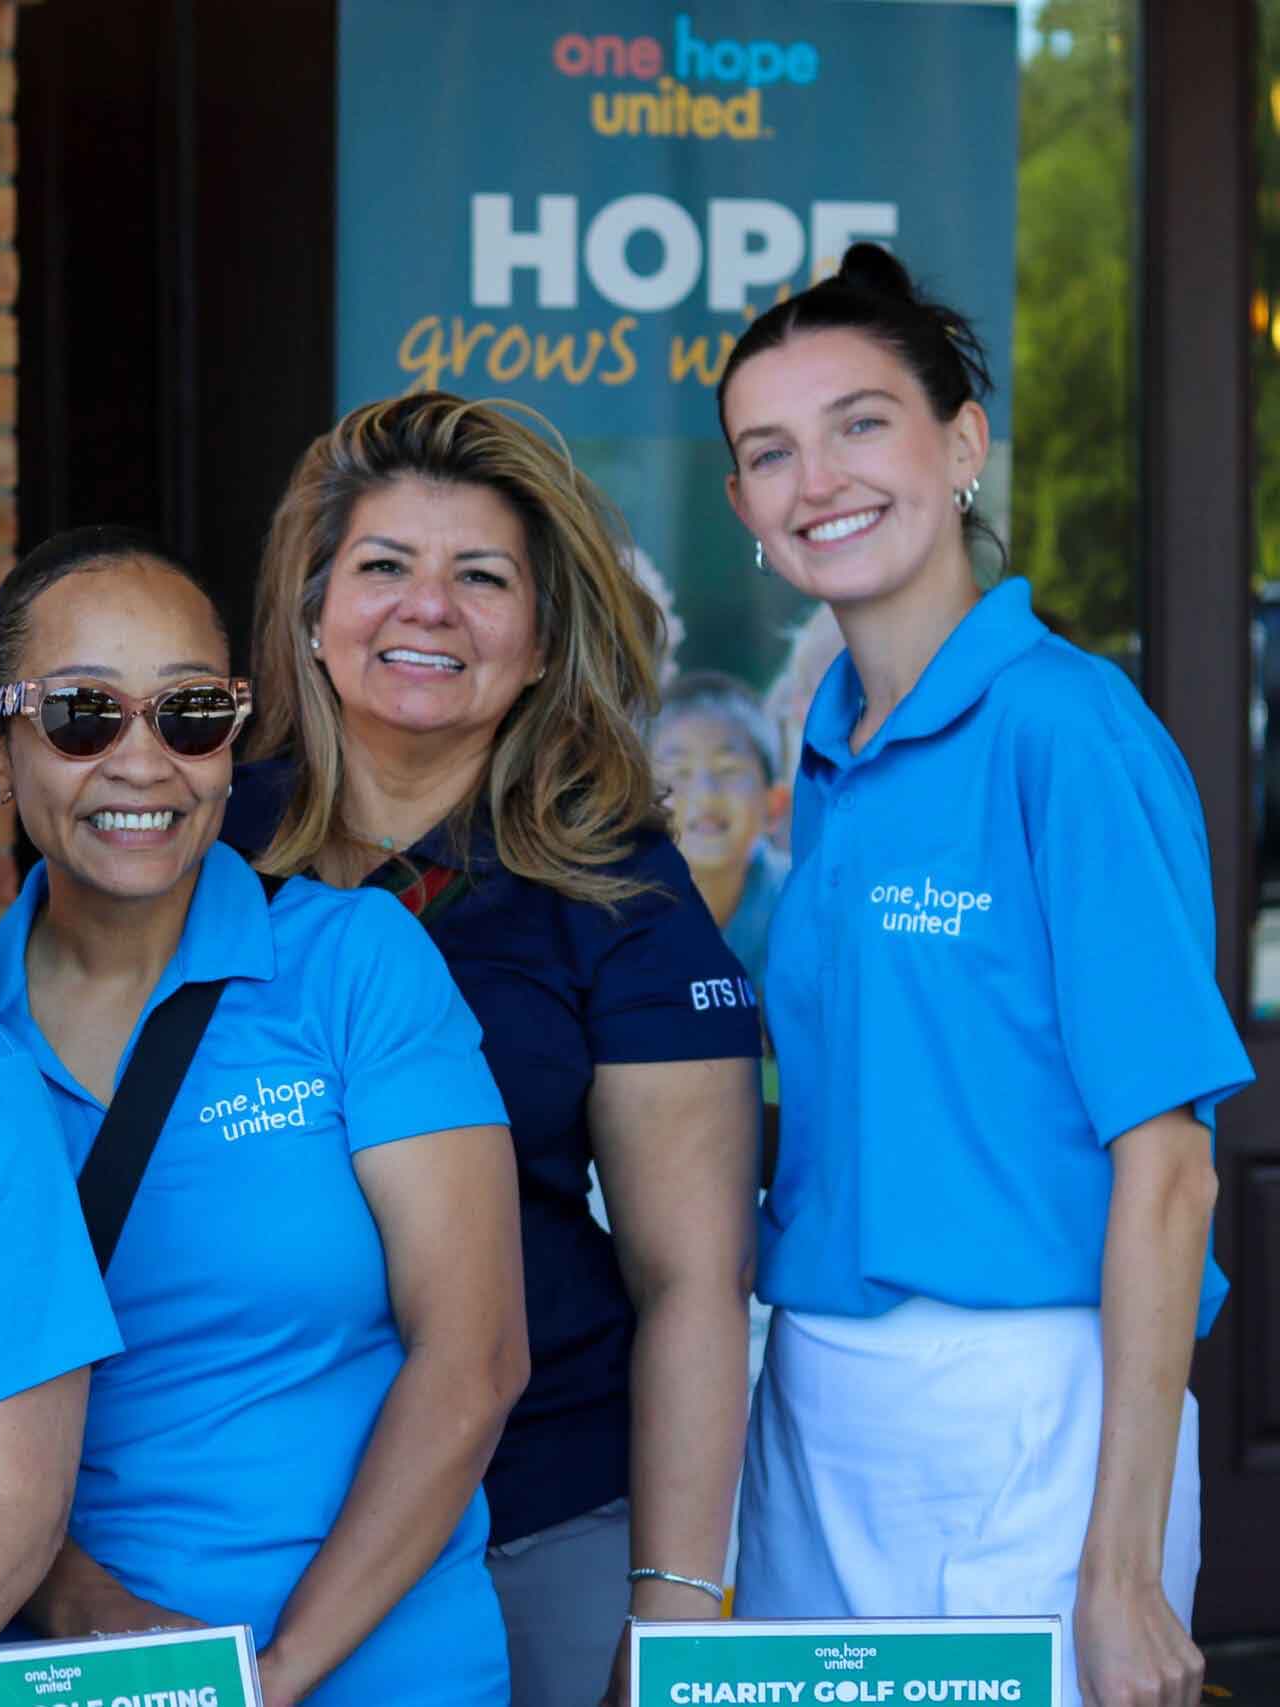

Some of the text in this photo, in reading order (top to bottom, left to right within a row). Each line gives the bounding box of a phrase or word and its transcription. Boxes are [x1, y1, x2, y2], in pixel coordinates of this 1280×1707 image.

[553, 13, 818, 86] one hope
[591, 76, 763, 139] united
[399, 315, 640, 393] grows
[871, 876, 992, 912] one hope
[882, 909, 961, 936] united
[690, 978, 737, 1011] BTS
[200, 1077, 325, 1123] one hope
[223, 1103, 305, 1141] united
[815, 1642, 877, 1660] one hope
[824, 1658, 863, 1670] united
[24, 1664, 82, 1684] one hope
[35, 1680, 72, 1695] united
[671, 1679, 1021, 1704] CHARITY GOLF OUTING
